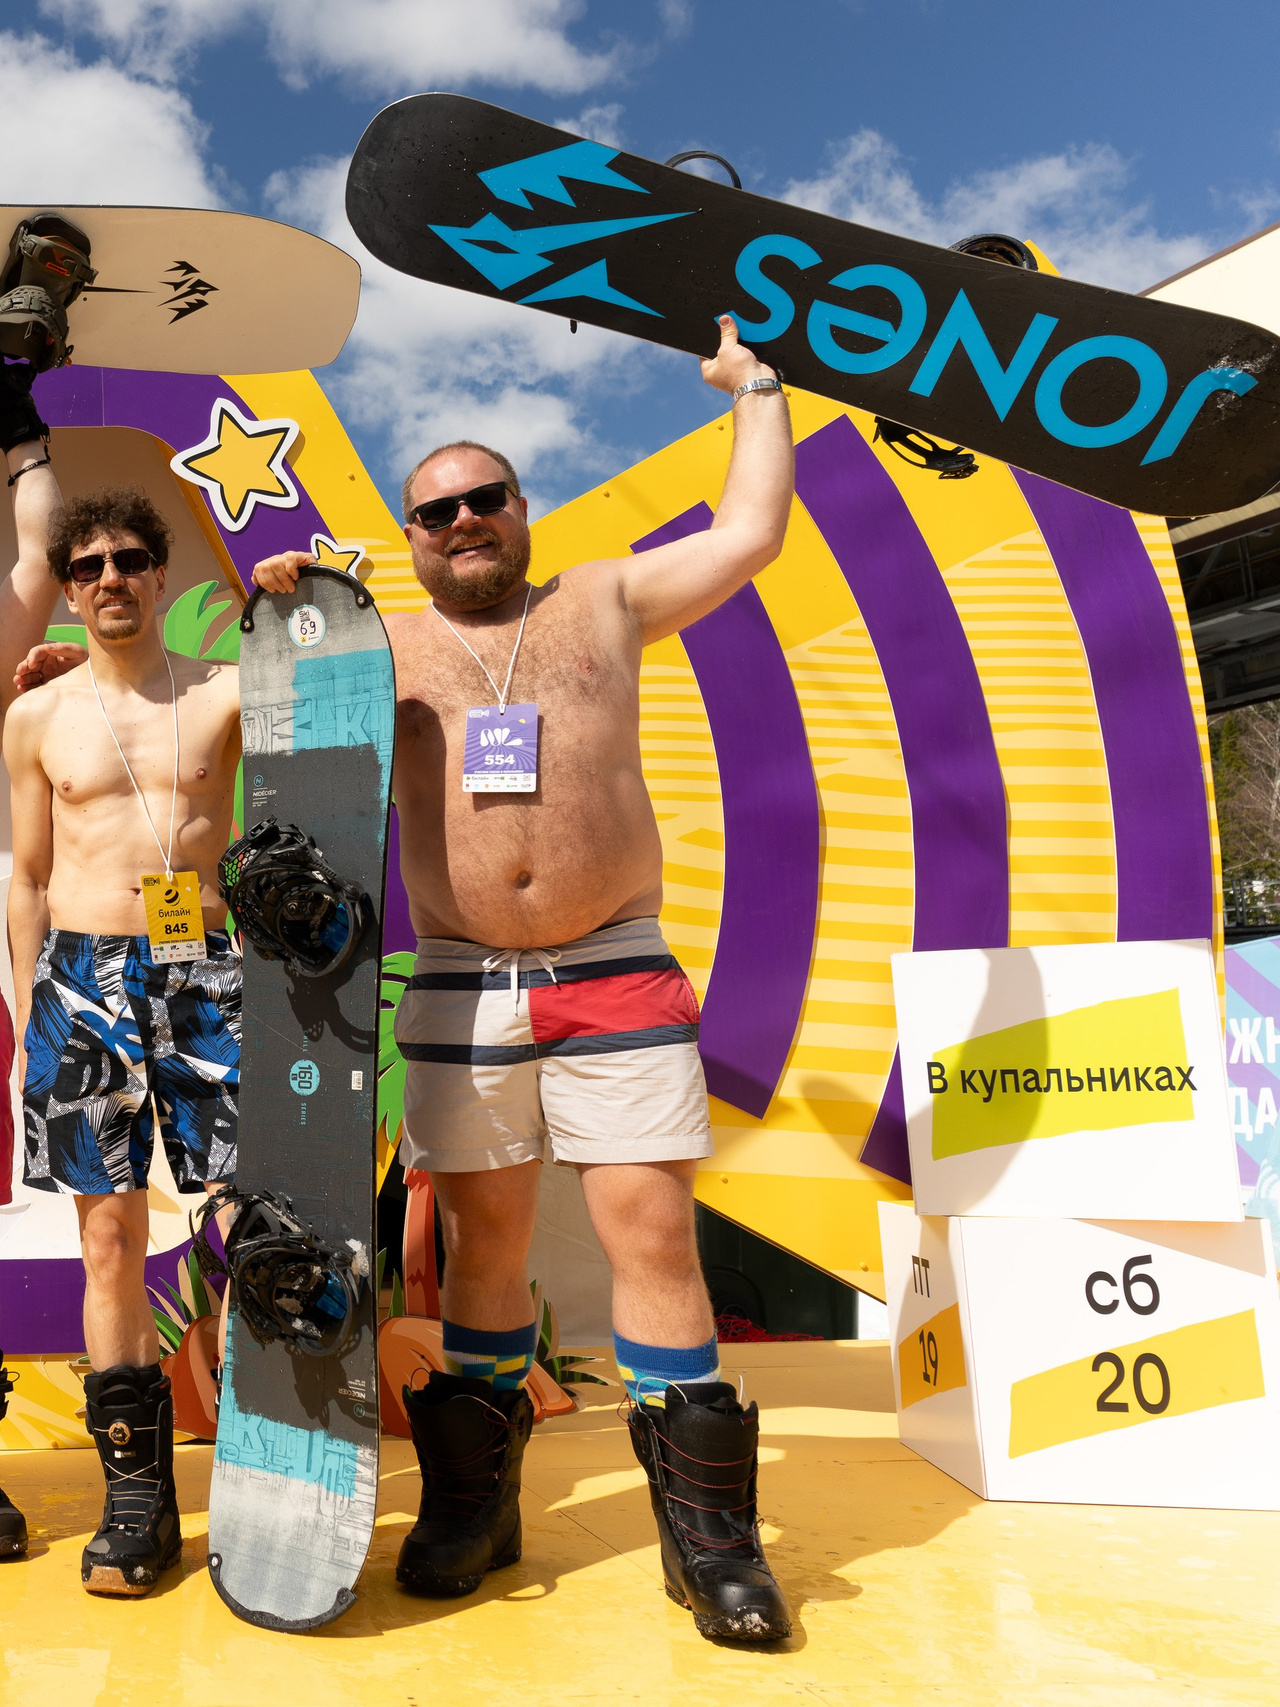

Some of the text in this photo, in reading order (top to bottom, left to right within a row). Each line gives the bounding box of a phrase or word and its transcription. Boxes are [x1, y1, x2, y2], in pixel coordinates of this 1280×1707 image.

[300, 620, 317, 636] 69
[484, 753, 515, 766] 554
[158, 907, 191, 918] билайн
[165, 923, 188, 935] 845
[298, 1064, 313, 1090] 160
[927, 1060, 1198, 1102] В купальниках
[910, 1254, 931, 1299] пт
[1084, 1254, 1161, 1317] сб
[917, 1328, 939, 1388] 19
[1090, 1350, 1171, 1415] 20
